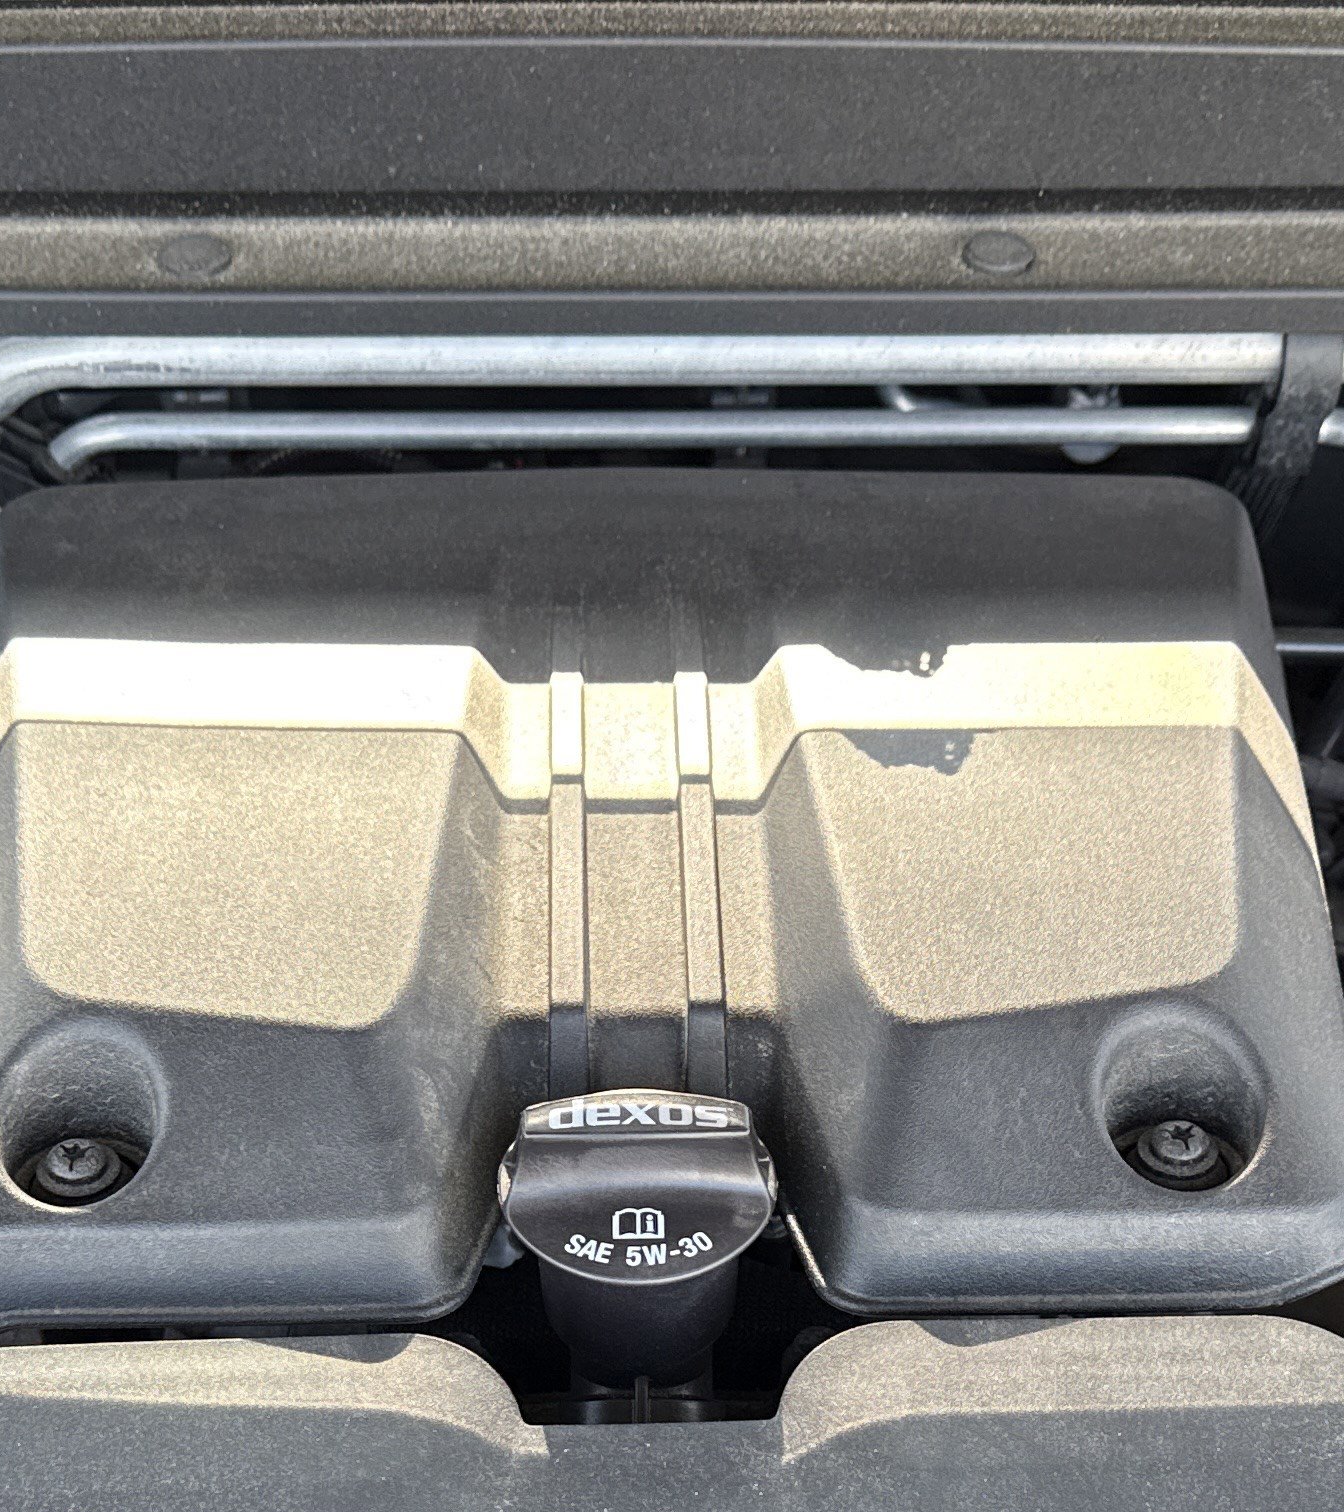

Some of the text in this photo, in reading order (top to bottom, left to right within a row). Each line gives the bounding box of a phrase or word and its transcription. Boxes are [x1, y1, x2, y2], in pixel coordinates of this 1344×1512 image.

[549, 1099, 728, 1129] dexos
[564, 1231, 713, 1266] SAE 5W-30
